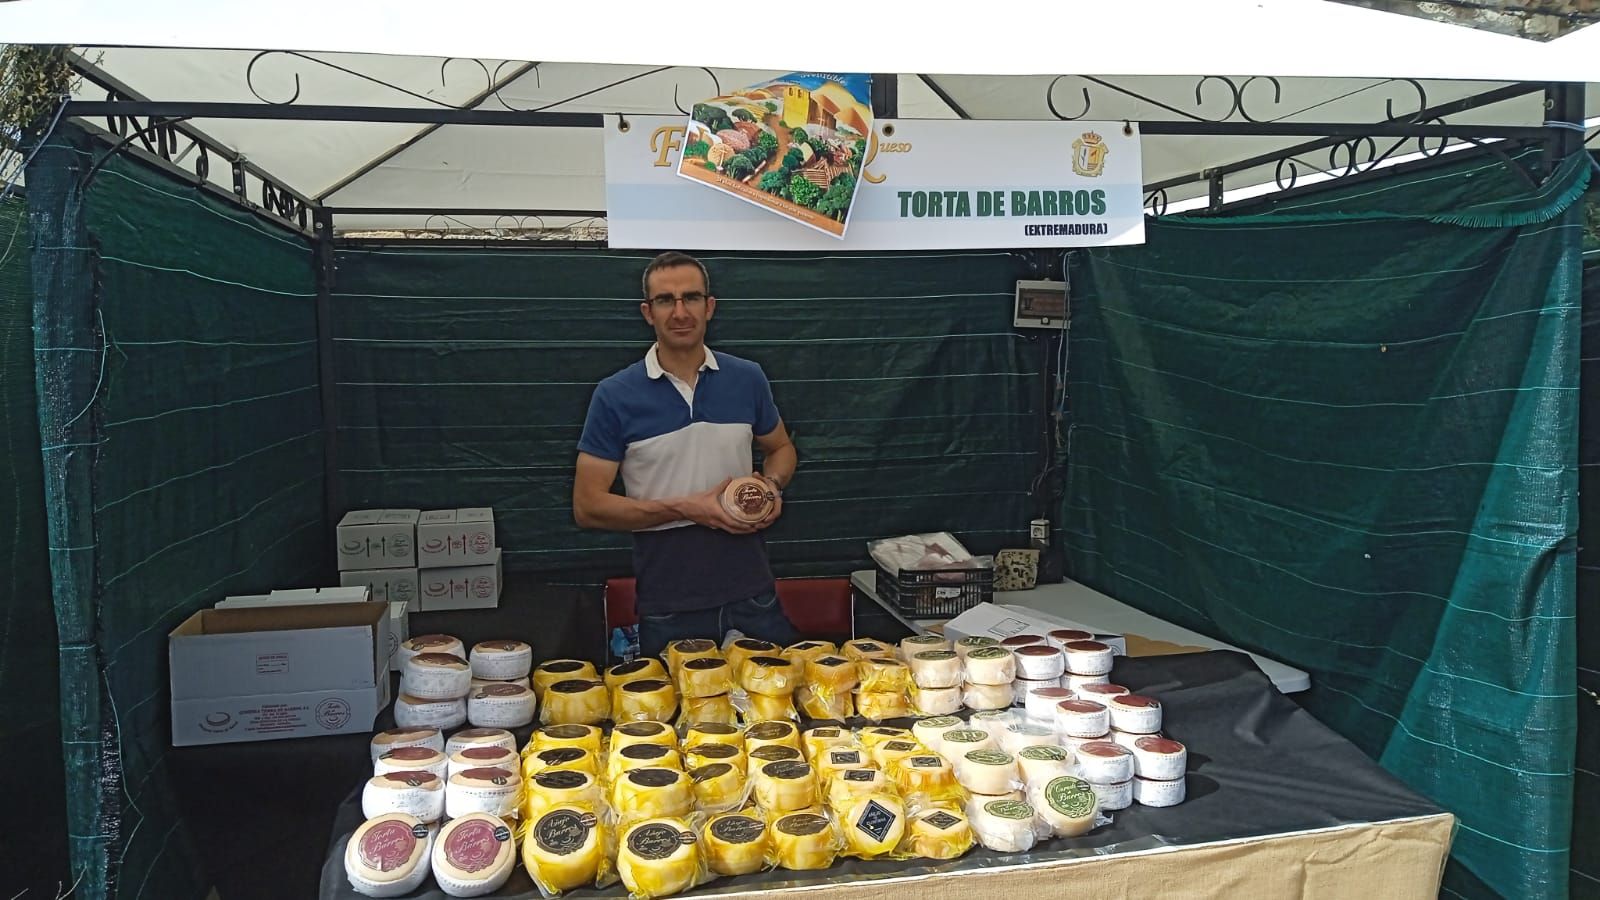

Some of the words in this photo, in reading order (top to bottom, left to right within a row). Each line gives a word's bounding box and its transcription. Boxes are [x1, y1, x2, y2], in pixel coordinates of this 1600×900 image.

[897, 190, 971, 218] TORTA
[976, 190, 1005, 217] DE
[1011, 189, 1107, 217] BARROS
[1024, 223, 1108, 236] (EXTREMADURA)
